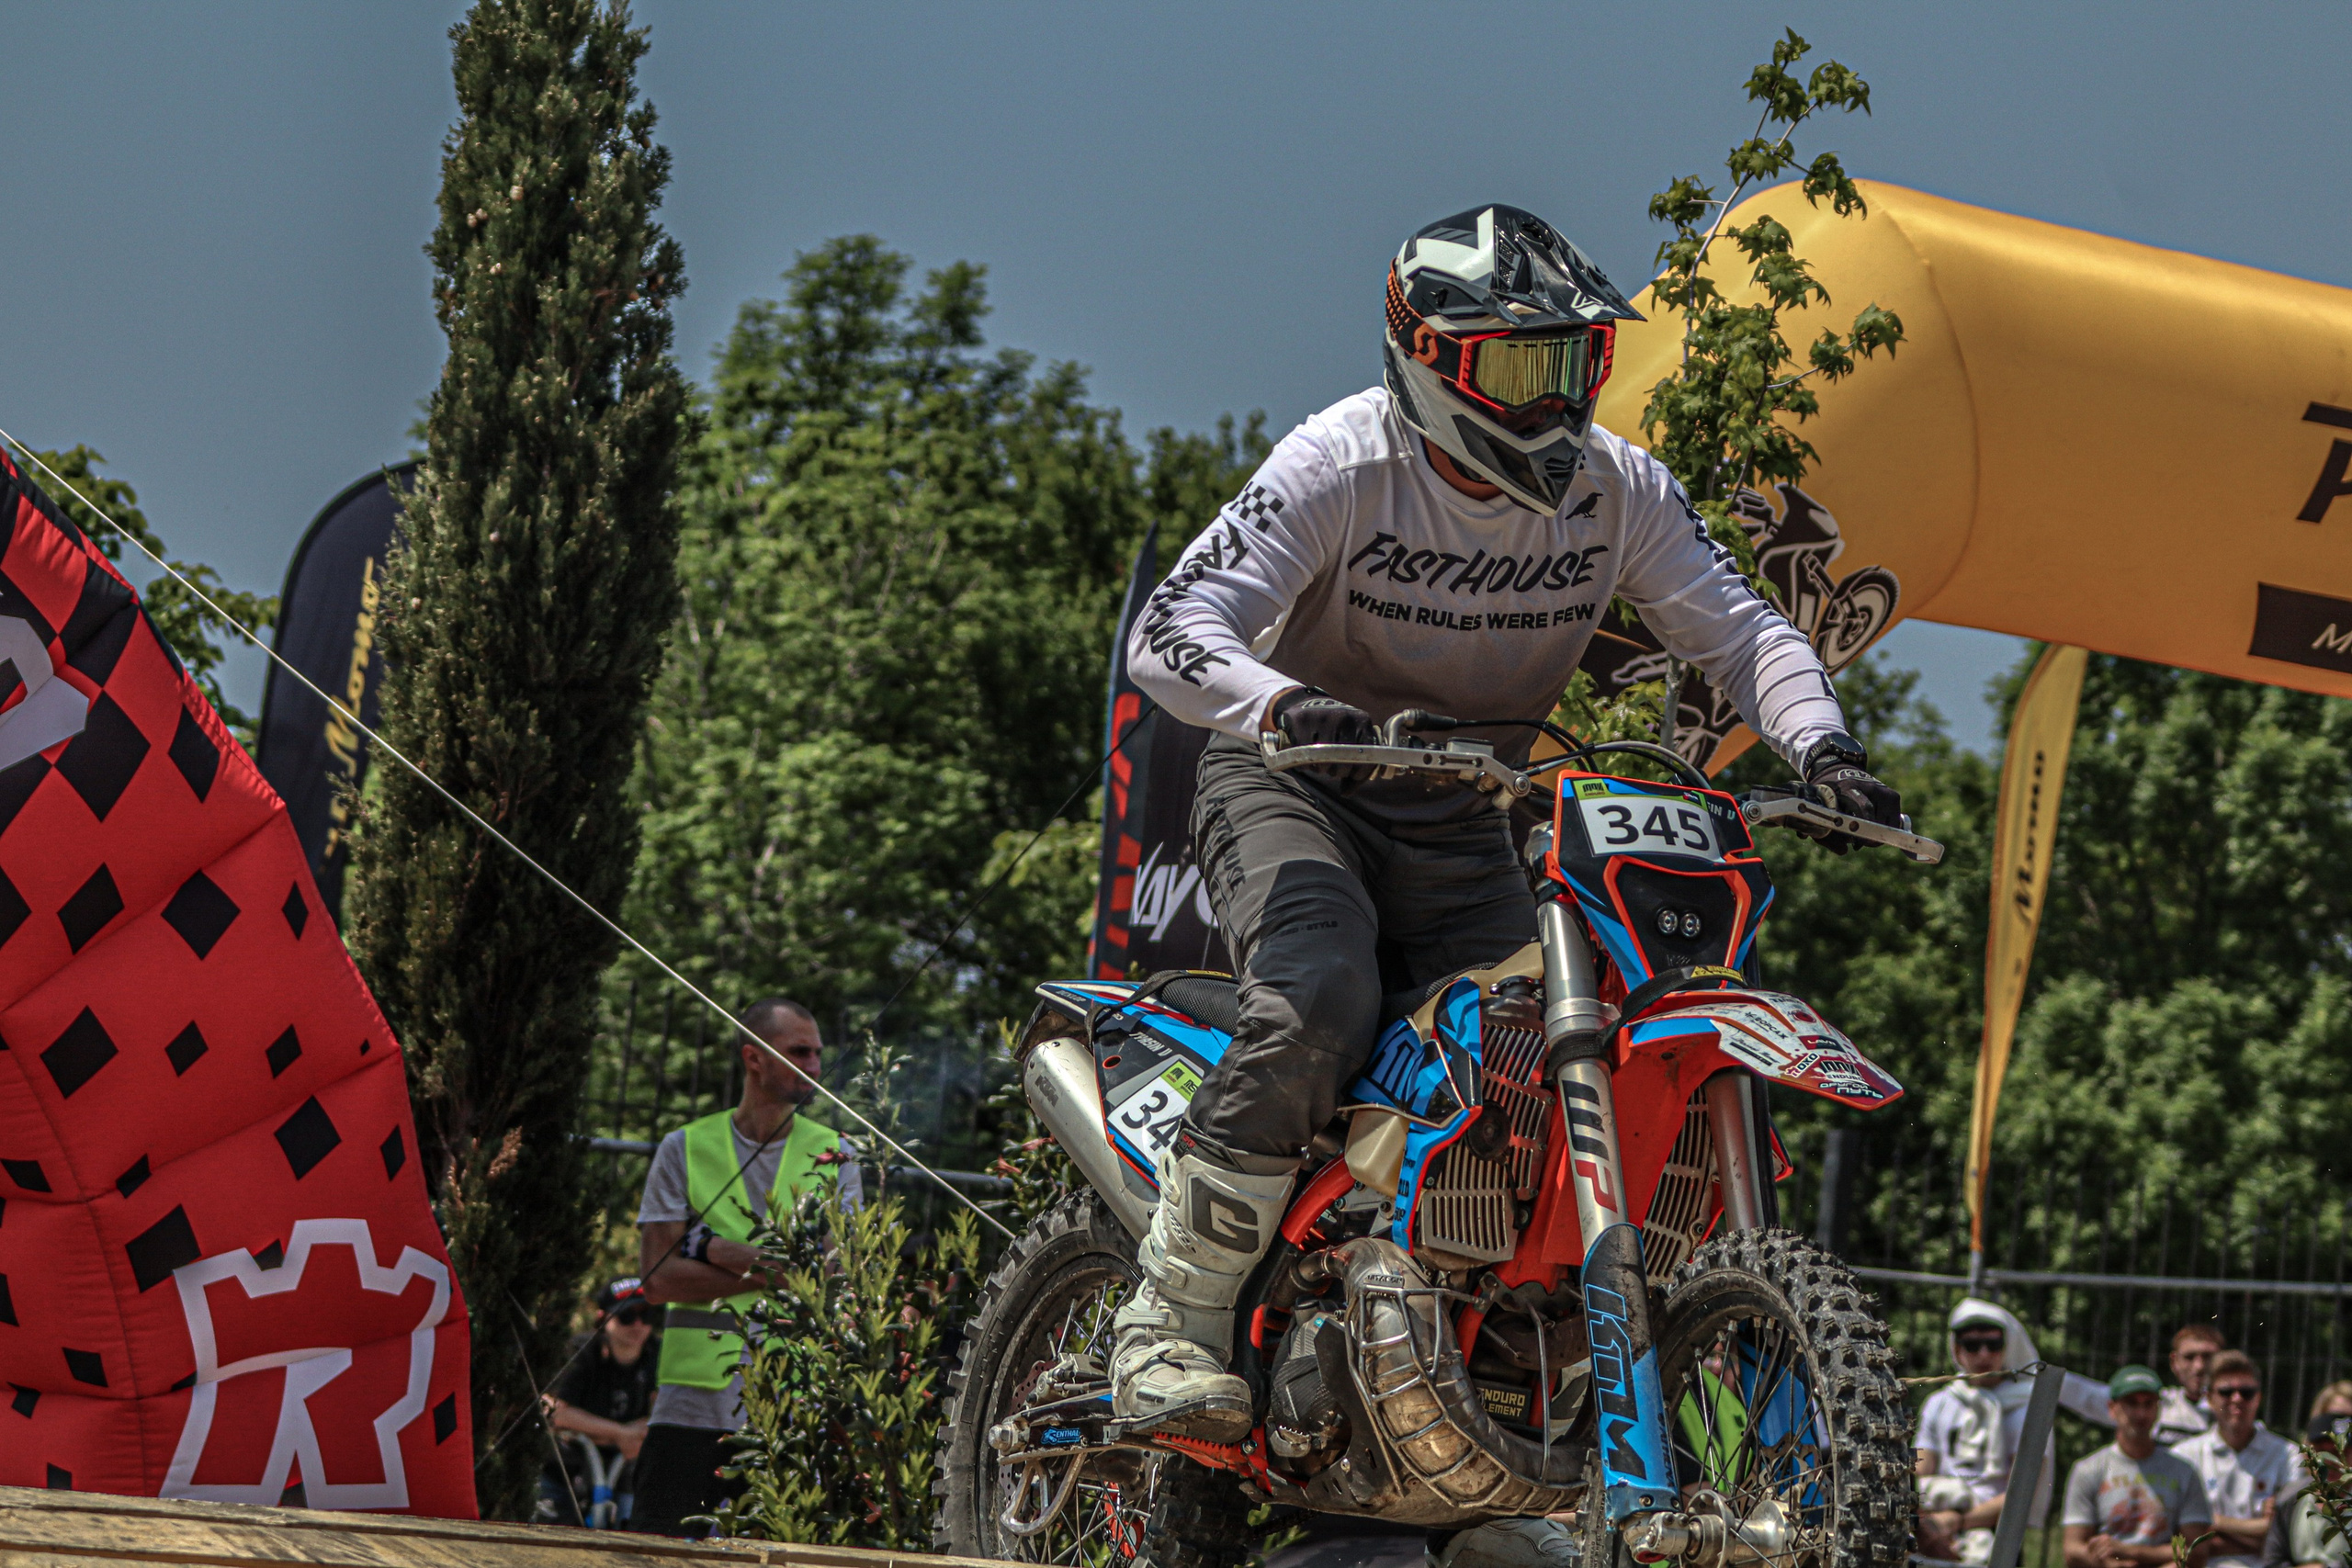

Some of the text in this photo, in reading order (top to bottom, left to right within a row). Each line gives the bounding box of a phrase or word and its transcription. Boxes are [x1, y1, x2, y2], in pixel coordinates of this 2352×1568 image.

[1347, 531, 1609, 596] FASTHOUSE
[1349, 589, 1595, 631] WHEN RULES WERE FEW
[1597, 805, 1710, 851] 345
[1586, 1283, 1647, 1481] KTM
